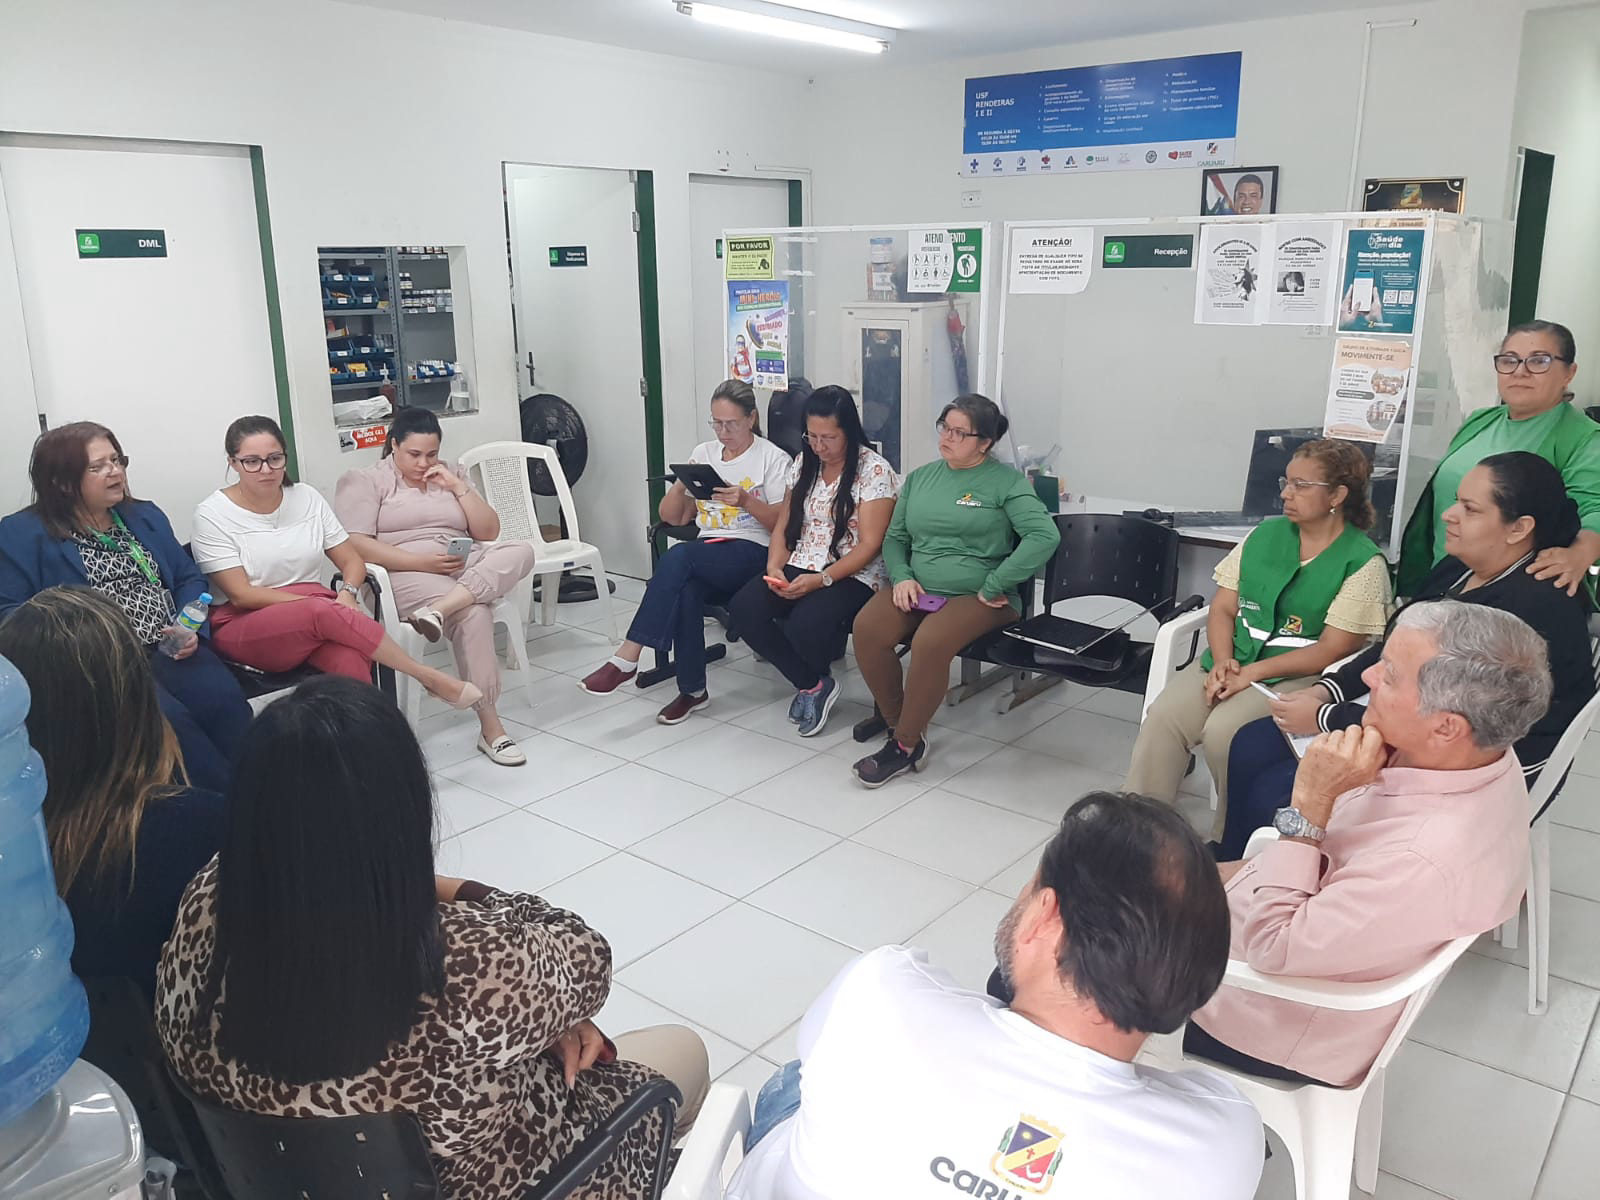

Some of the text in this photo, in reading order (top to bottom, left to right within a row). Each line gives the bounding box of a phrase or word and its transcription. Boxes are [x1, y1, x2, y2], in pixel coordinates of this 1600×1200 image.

[975, 91, 989, 100] USF
[975, 98, 1015, 108] RENDEIRAS
[138, 239, 162, 248] DML
[1032, 238, 1072, 247] ATENÇÃO!
[1154, 248, 1188, 256] Recepção
[1341, 352, 1394, 361] MOVIMENTE-SE
